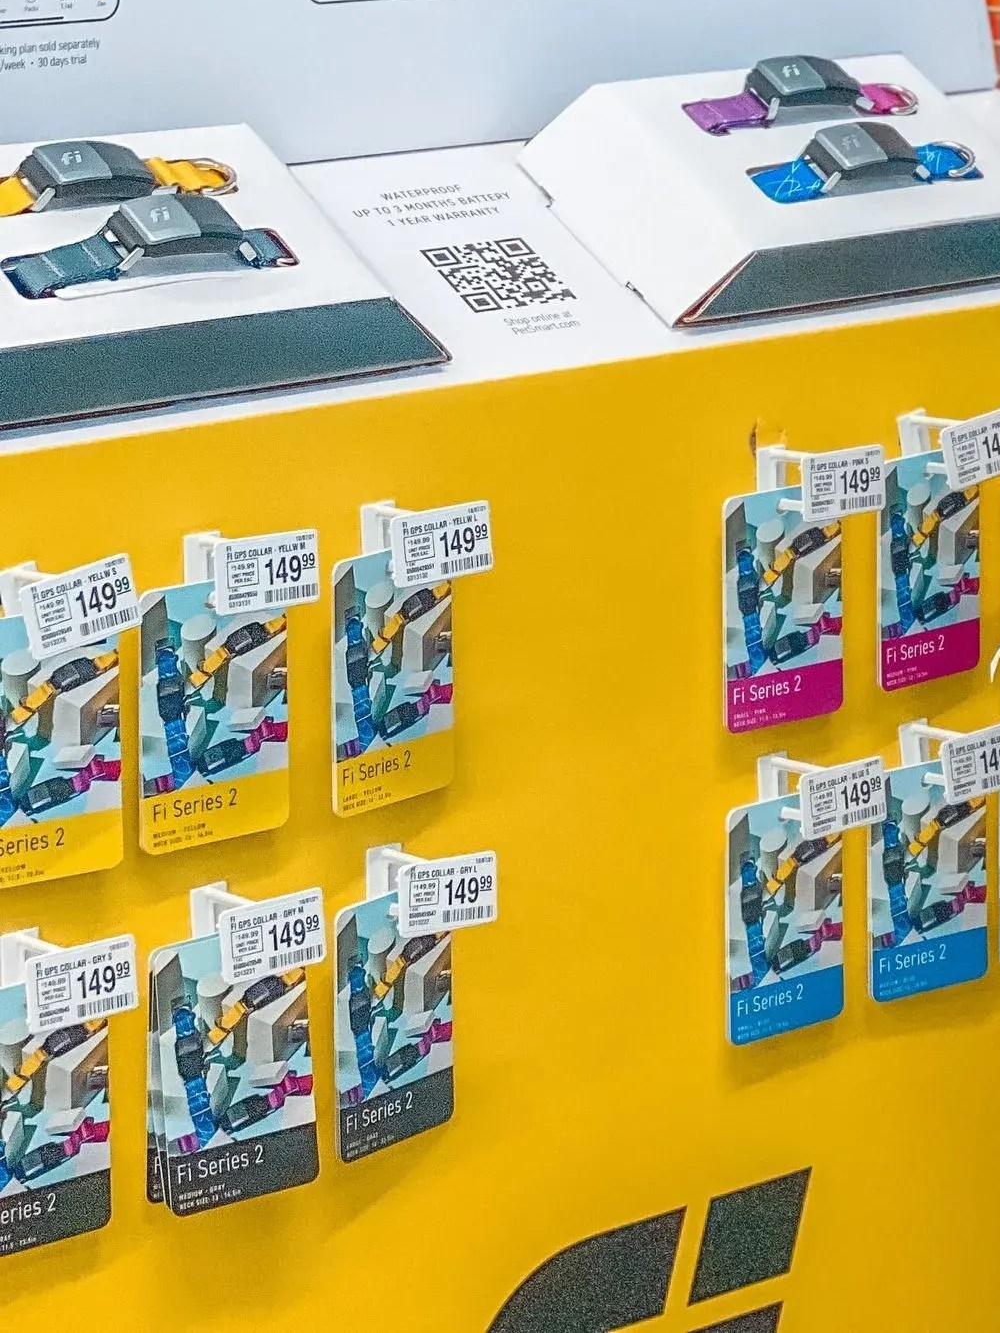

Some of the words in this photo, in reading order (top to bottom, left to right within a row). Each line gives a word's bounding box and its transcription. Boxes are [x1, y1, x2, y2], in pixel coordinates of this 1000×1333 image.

[19, 43, 37, 55] plan
[39, 40, 56, 52] sold
[58, 38, 100, 52] separately
[38, 56, 48, 67] 30
[50, 56, 69, 68] days
[71, 53, 87, 64] trial
[352, 208, 371, 218] UP
[373, 206, 391, 216] TO
[393, 205, 402, 213] 3
[404, 198, 456, 212] MONTHS
[458, 191, 510, 206] BATTERY
[380, 184, 462, 201] WATERPROOF
[397, 215, 432, 226] YEAR
[432, 206, 500, 221] WARRANTY
[503, 317, 530, 326] Shop
[531, 313, 560, 323] online
[886, 646, 897, 664] Fi
[900, 640, 935, 661] Series
[938, 634, 945, 651] 2
[733, 687, 745, 705] Fi
[749, 680, 790, 701] Series
[794, 674, 802, 692] 2
[342, 767, 354, 786] Fi
[360, 757, 399, 781] Series
[404, 750, 411, 768] 2
[153, 803, 167, 822] Fi
[173, 794, 223, 818] Series
[229, 788, 237, 807] 2
[55, 827, 65, 847] 2
[879, 957, 890, 974] Fi
[895, 949, 935, 970] Series
[939, 944, 946, 960] 2
[737, 999, 748, 1017] Fi
[753, 989, 792, 1013] Series
[796, 983, 804, 1000] 2
[346, 1113, 357, 1134] Fi
[362, 1099, 401, 1127] Series
[406, 1091, 413, 1109] 2
[178, 1163, 192, 1184] Fi
[199, 1152, 249, 1179] Series
[254, 1144, 264, 1163] 2
[47, 1192, 56, 1212] 2
